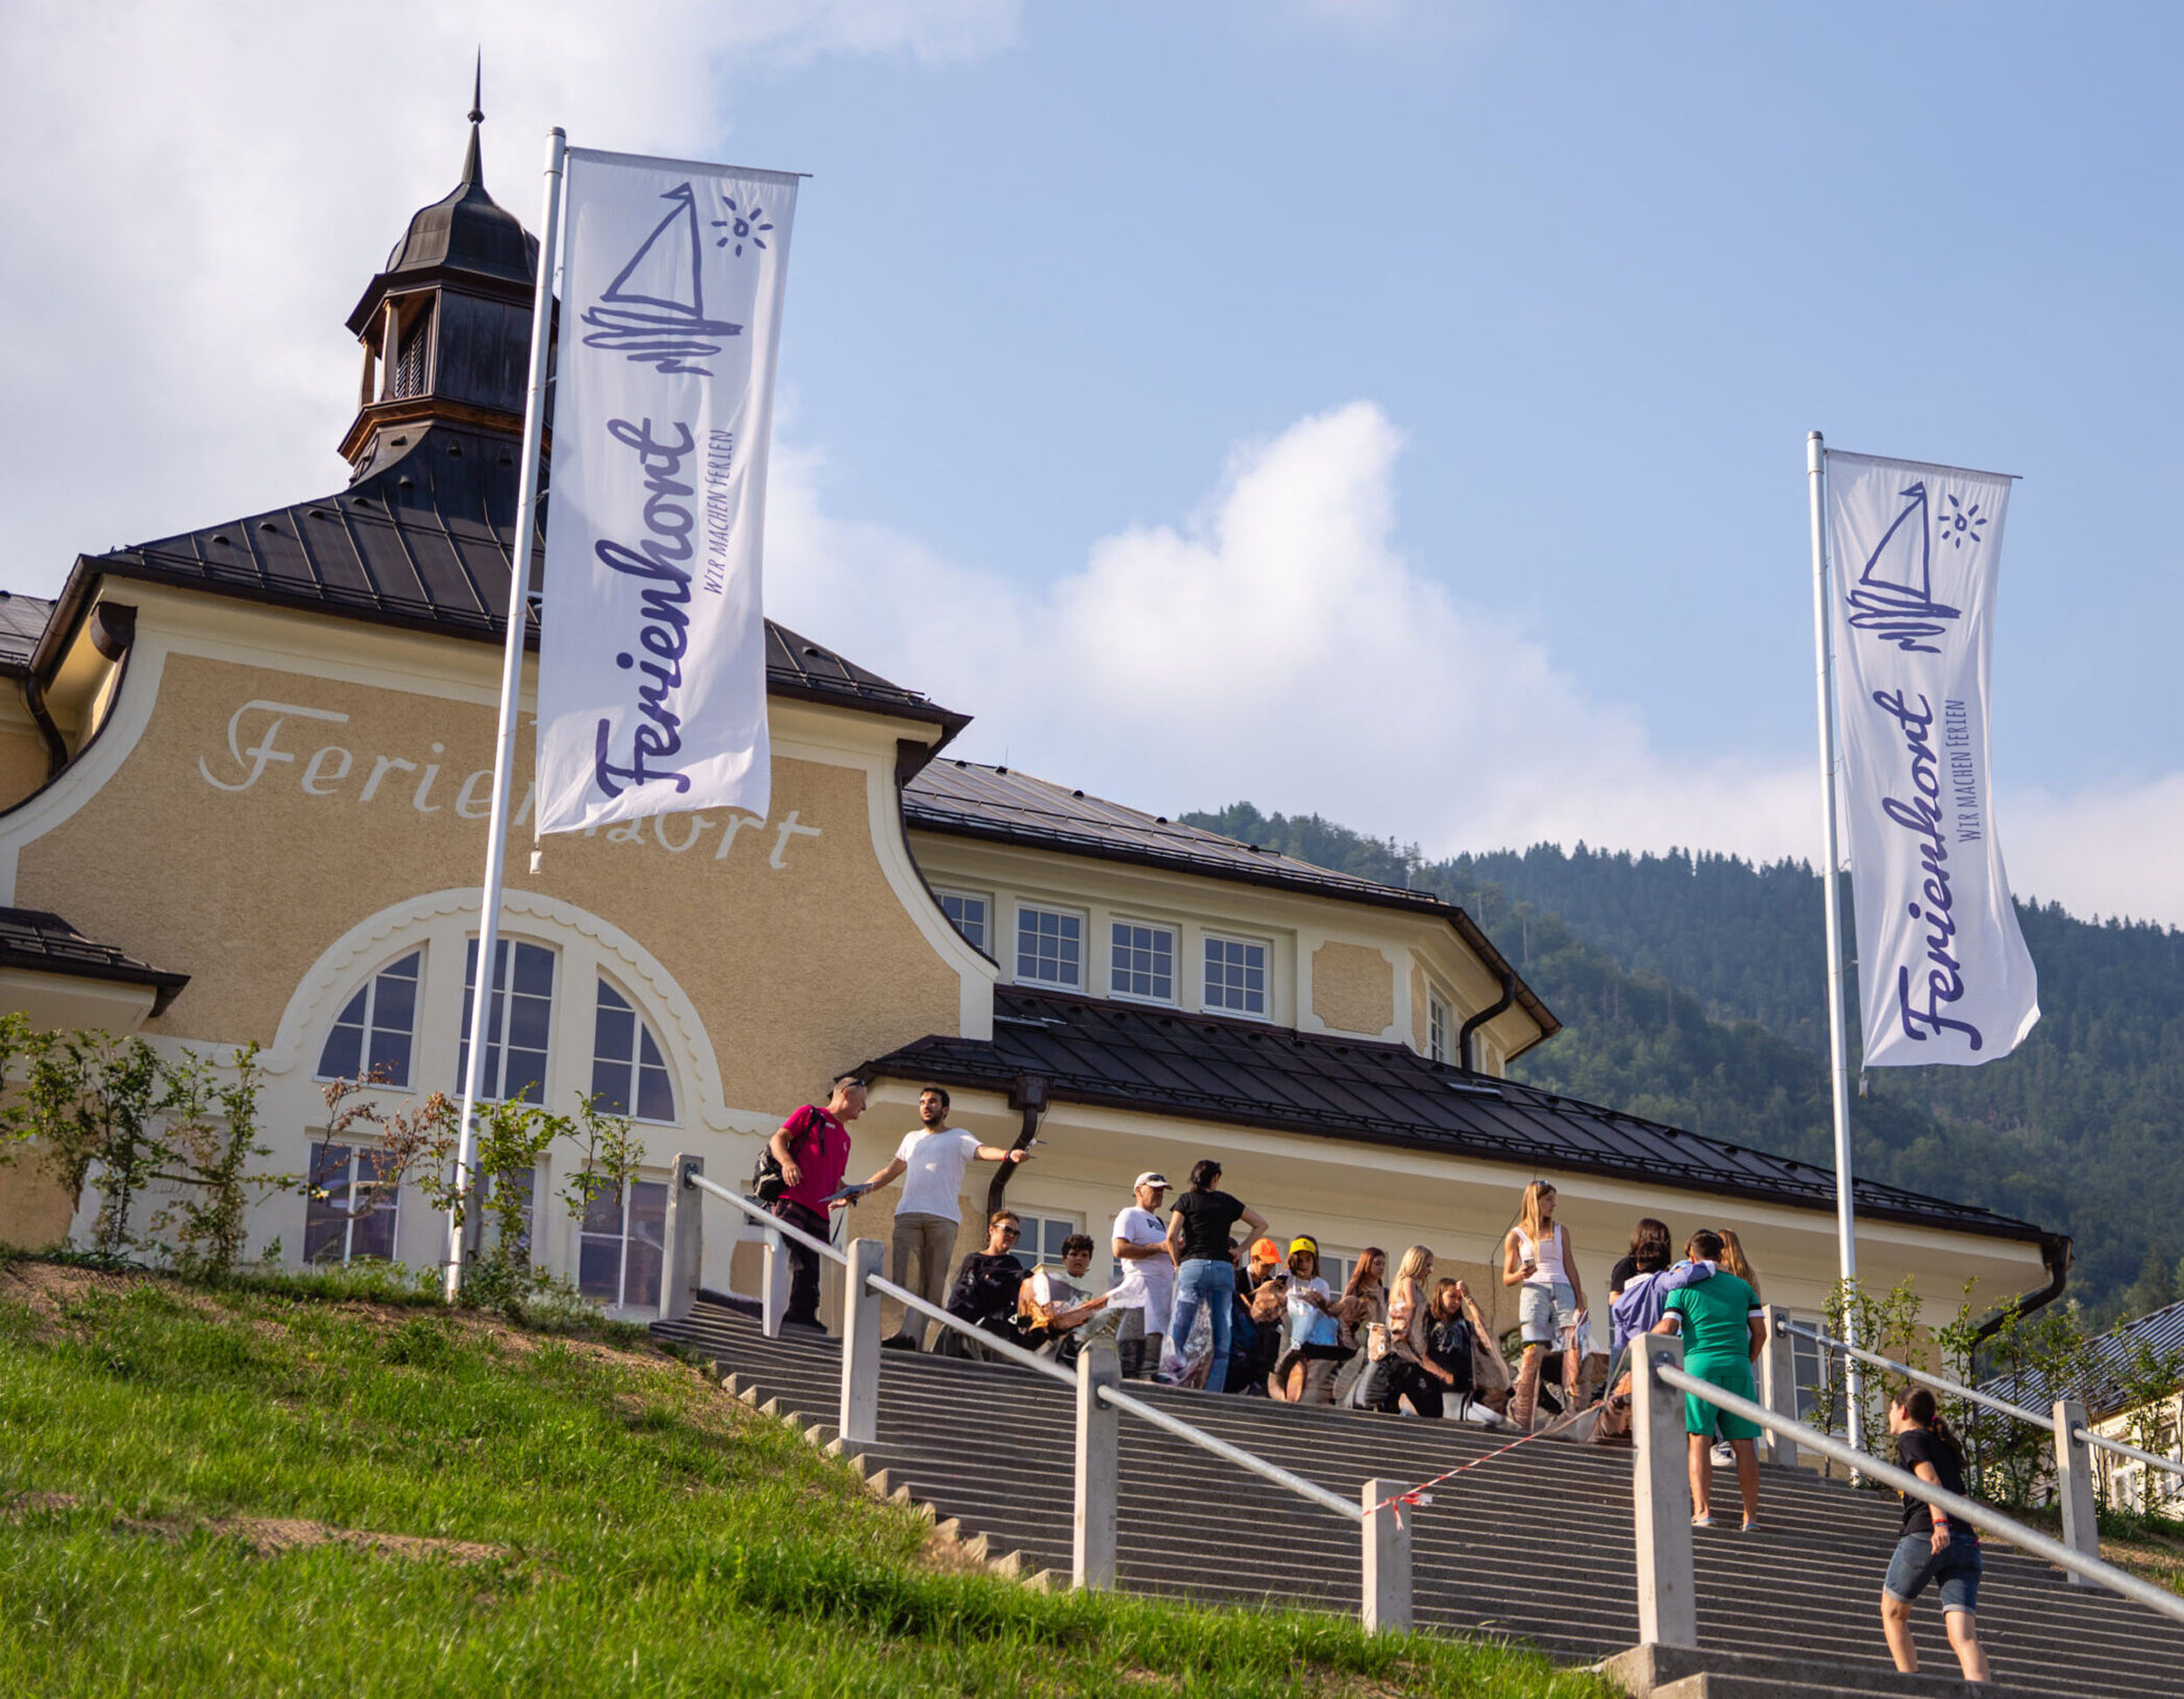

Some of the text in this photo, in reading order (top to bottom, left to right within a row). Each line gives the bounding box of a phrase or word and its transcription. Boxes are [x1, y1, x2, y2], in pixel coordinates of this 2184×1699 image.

[703, 429, 733, 595] WIR MACHEN FERIEN
[594, 417, 695, 800] Ferienhort
[199, 700, 822, 870] Ferieort
[1945, 700, 1981, 843] WIR MACHEN FERIEN
[1872, 688, 1982, 1052] Ferienhort
